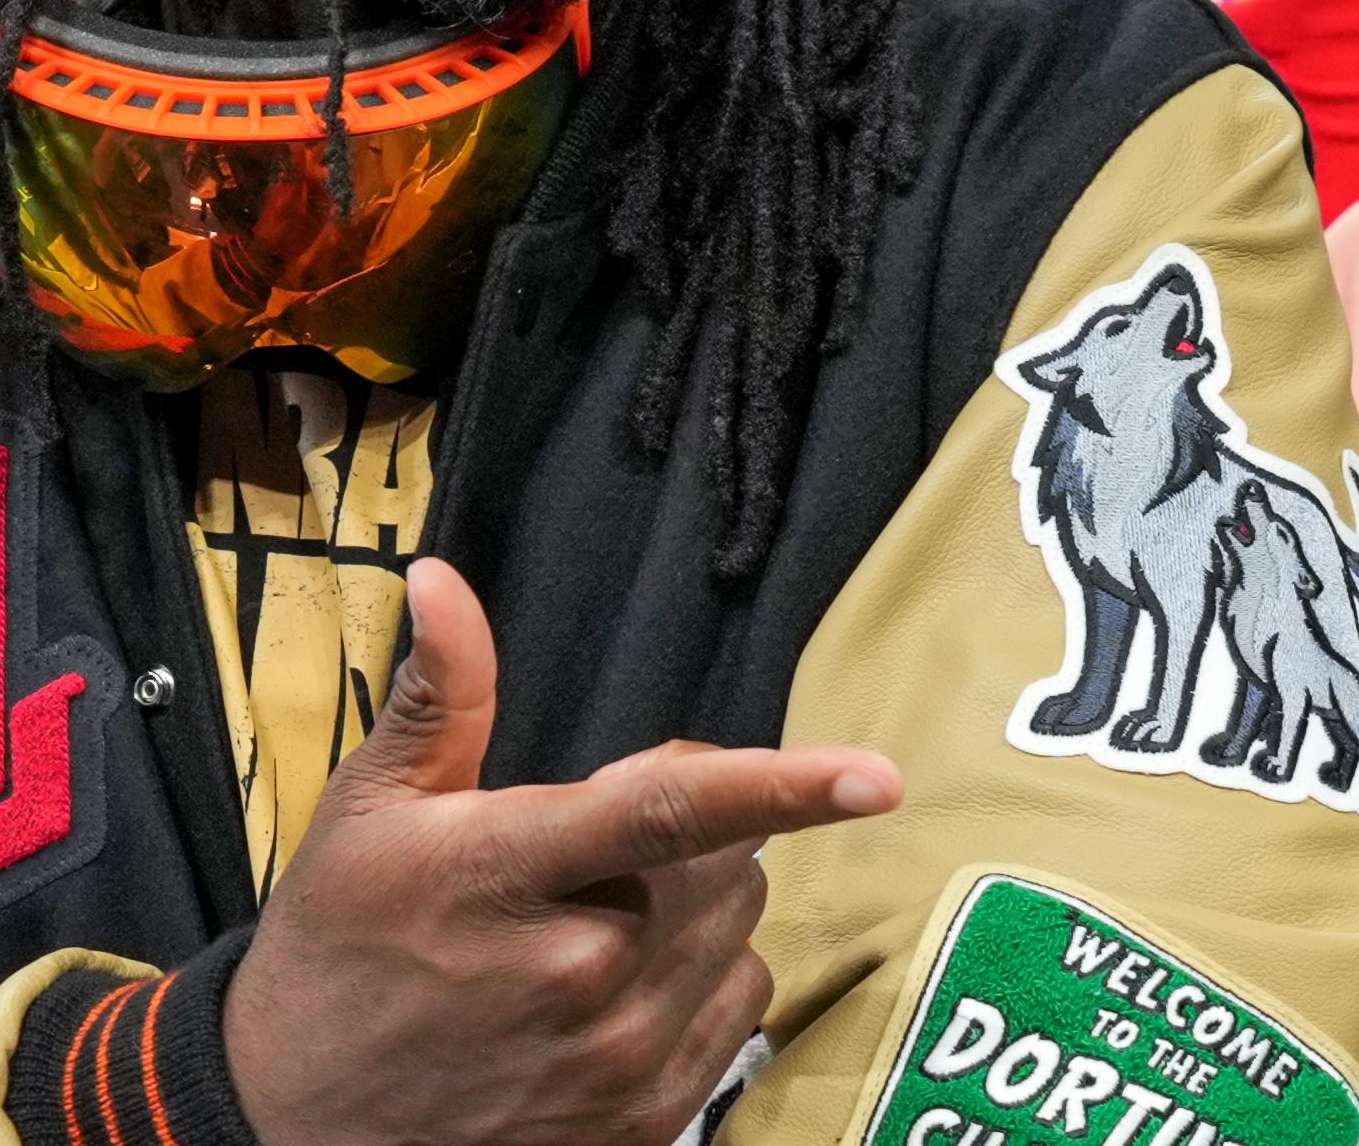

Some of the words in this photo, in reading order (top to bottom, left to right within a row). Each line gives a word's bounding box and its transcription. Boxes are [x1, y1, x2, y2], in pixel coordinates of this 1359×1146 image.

[922, 997, 1246, 1146] DORT
[1062, 924, 1298, 1097] WELCOME
[1091, 1008, 1141, 1050] TO
[1145, 1037, 1219, 1095] THE
